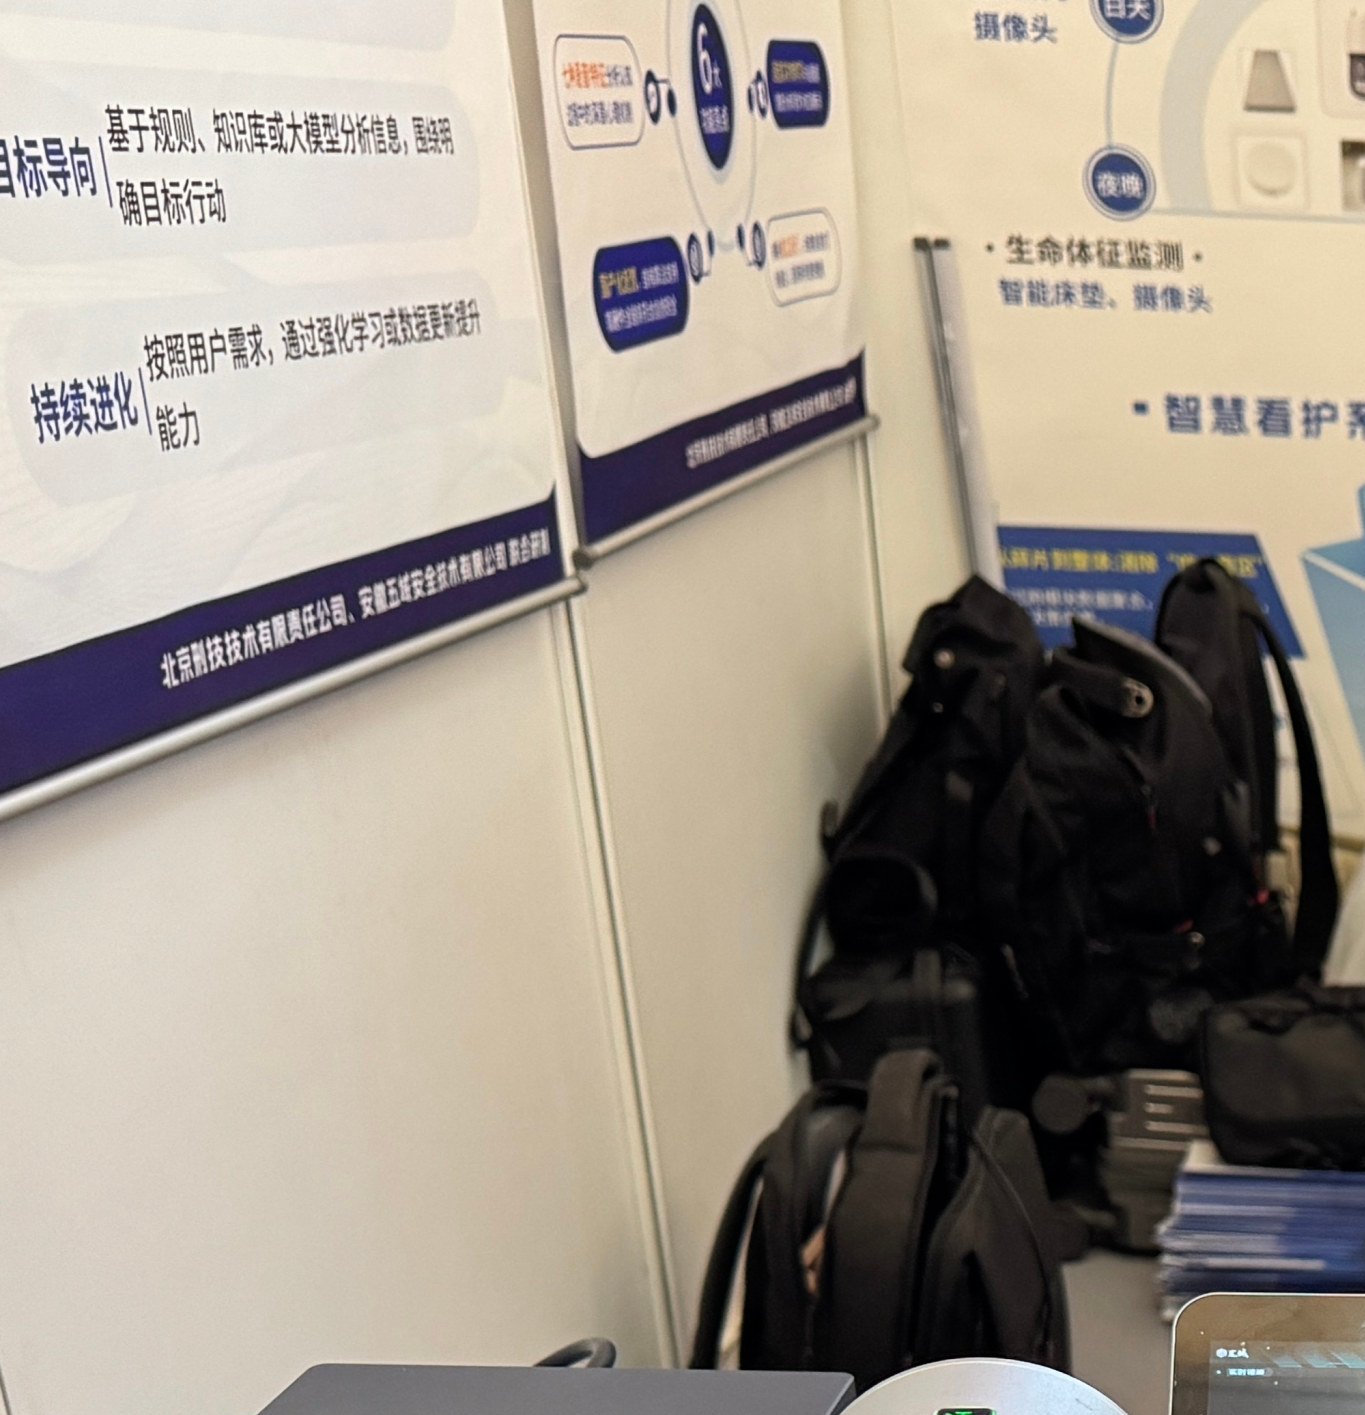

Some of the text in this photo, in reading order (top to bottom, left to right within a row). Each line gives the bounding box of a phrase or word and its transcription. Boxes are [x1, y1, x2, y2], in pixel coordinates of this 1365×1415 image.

[974, 11, 1058, 43] 摄像头
[115, 178, 228, 226] 确目标行动
[1006, 235, 1185, 272] 生命体征监测
[30, 371, 138, 443] 持续进化
[155, 402, 201, 452] 能力
